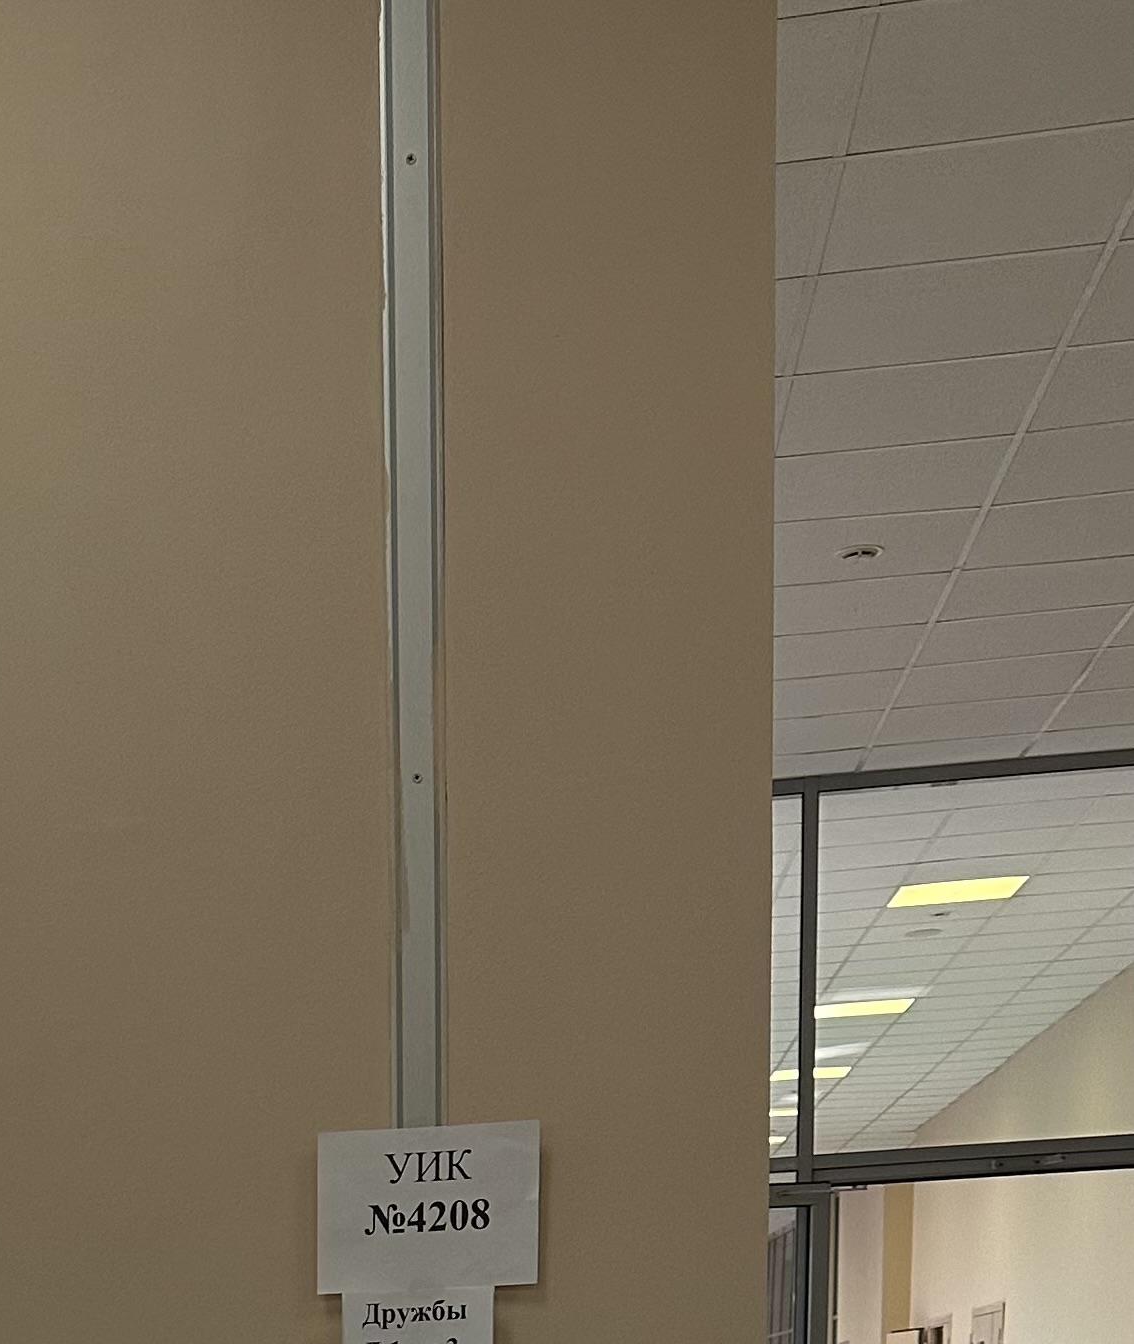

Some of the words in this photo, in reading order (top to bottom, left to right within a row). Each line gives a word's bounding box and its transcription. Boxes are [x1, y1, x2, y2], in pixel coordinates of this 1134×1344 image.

[384, 1148, 472, 1184] УИК
[364, 1198, 491, 1235] №4208
[362, 1300, 467, 1329] Дружбы
